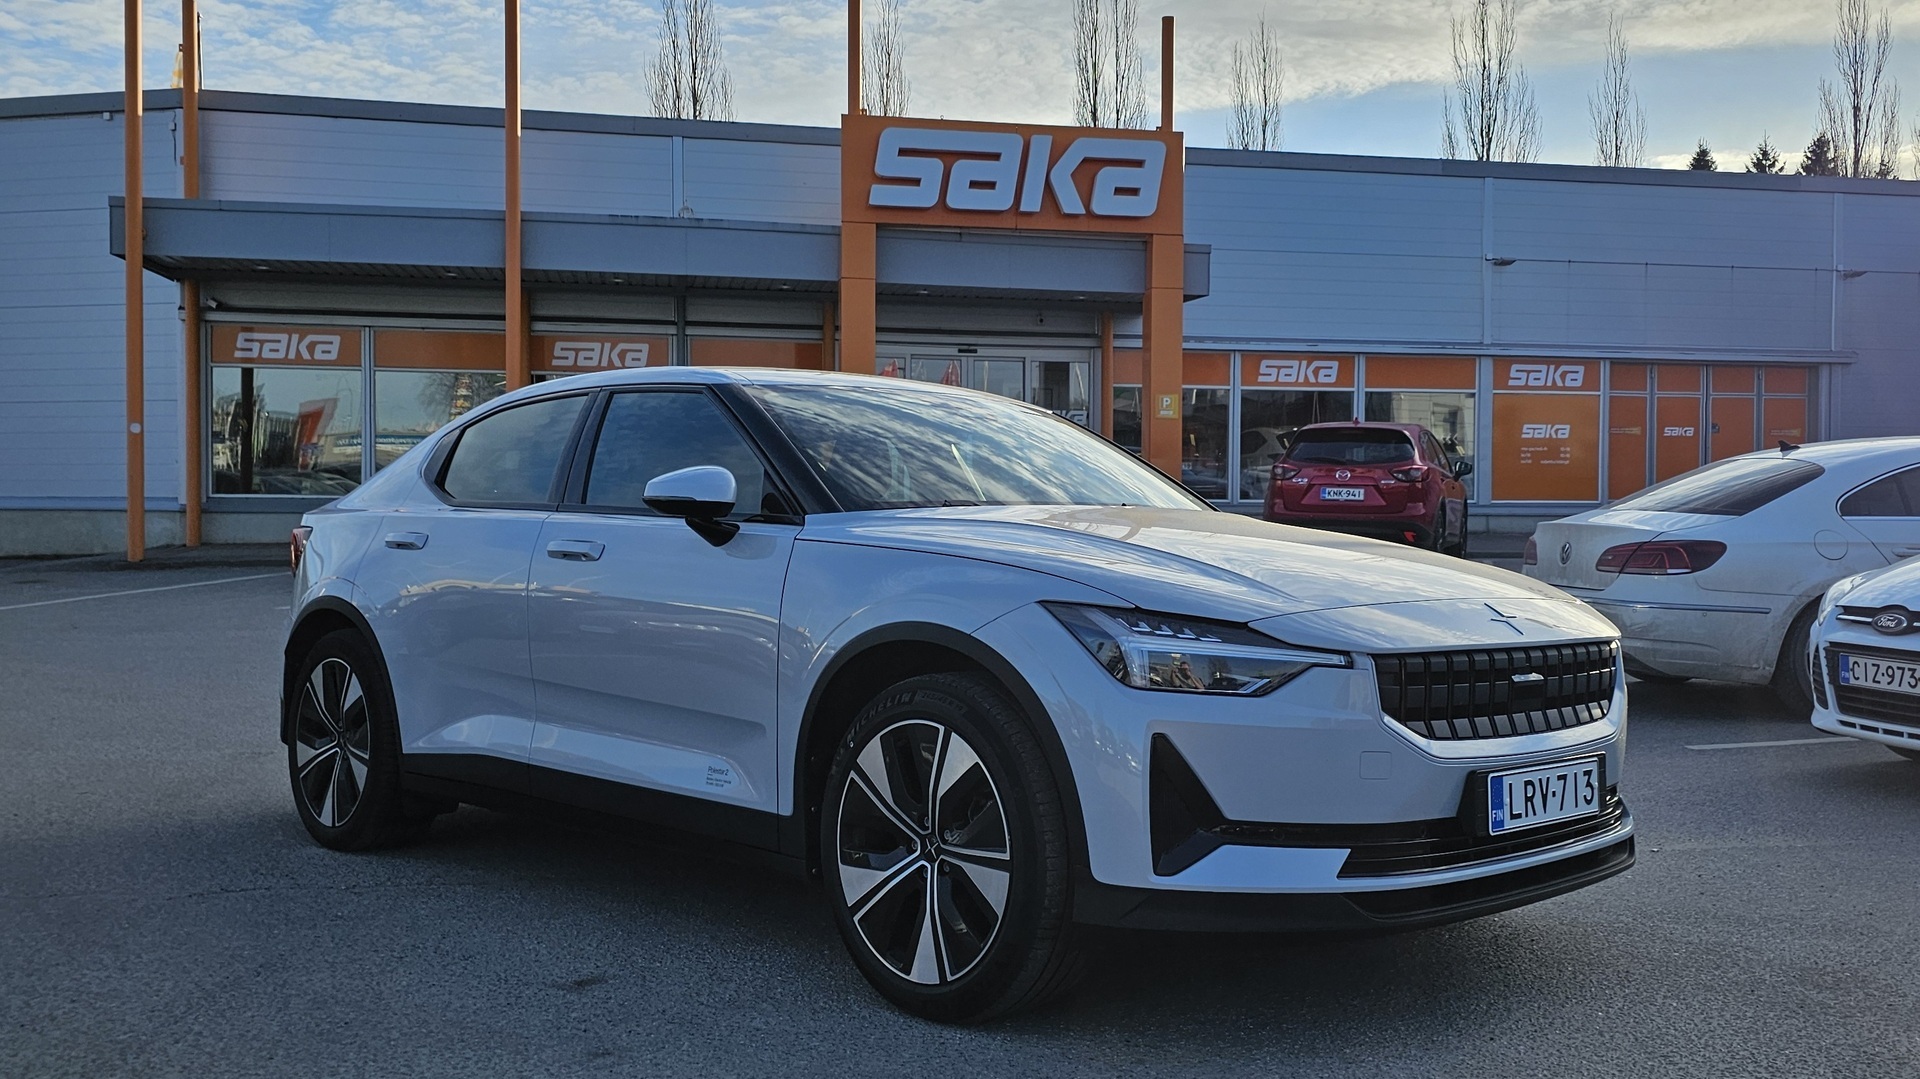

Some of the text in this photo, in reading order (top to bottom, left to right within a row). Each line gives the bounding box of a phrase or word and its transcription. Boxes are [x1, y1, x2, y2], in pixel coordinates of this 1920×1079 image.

[1327, 489, 1361, 498] KNK-941
[1877, 615, 1898, 628] Ford
[1852, 661, 1919, 689] CIZ-973
[847, 692, 912, 744] MICHELIN
[1509, 769, 1595, 821] LRV-713
[1492, 809, 1504, 823] FIN
